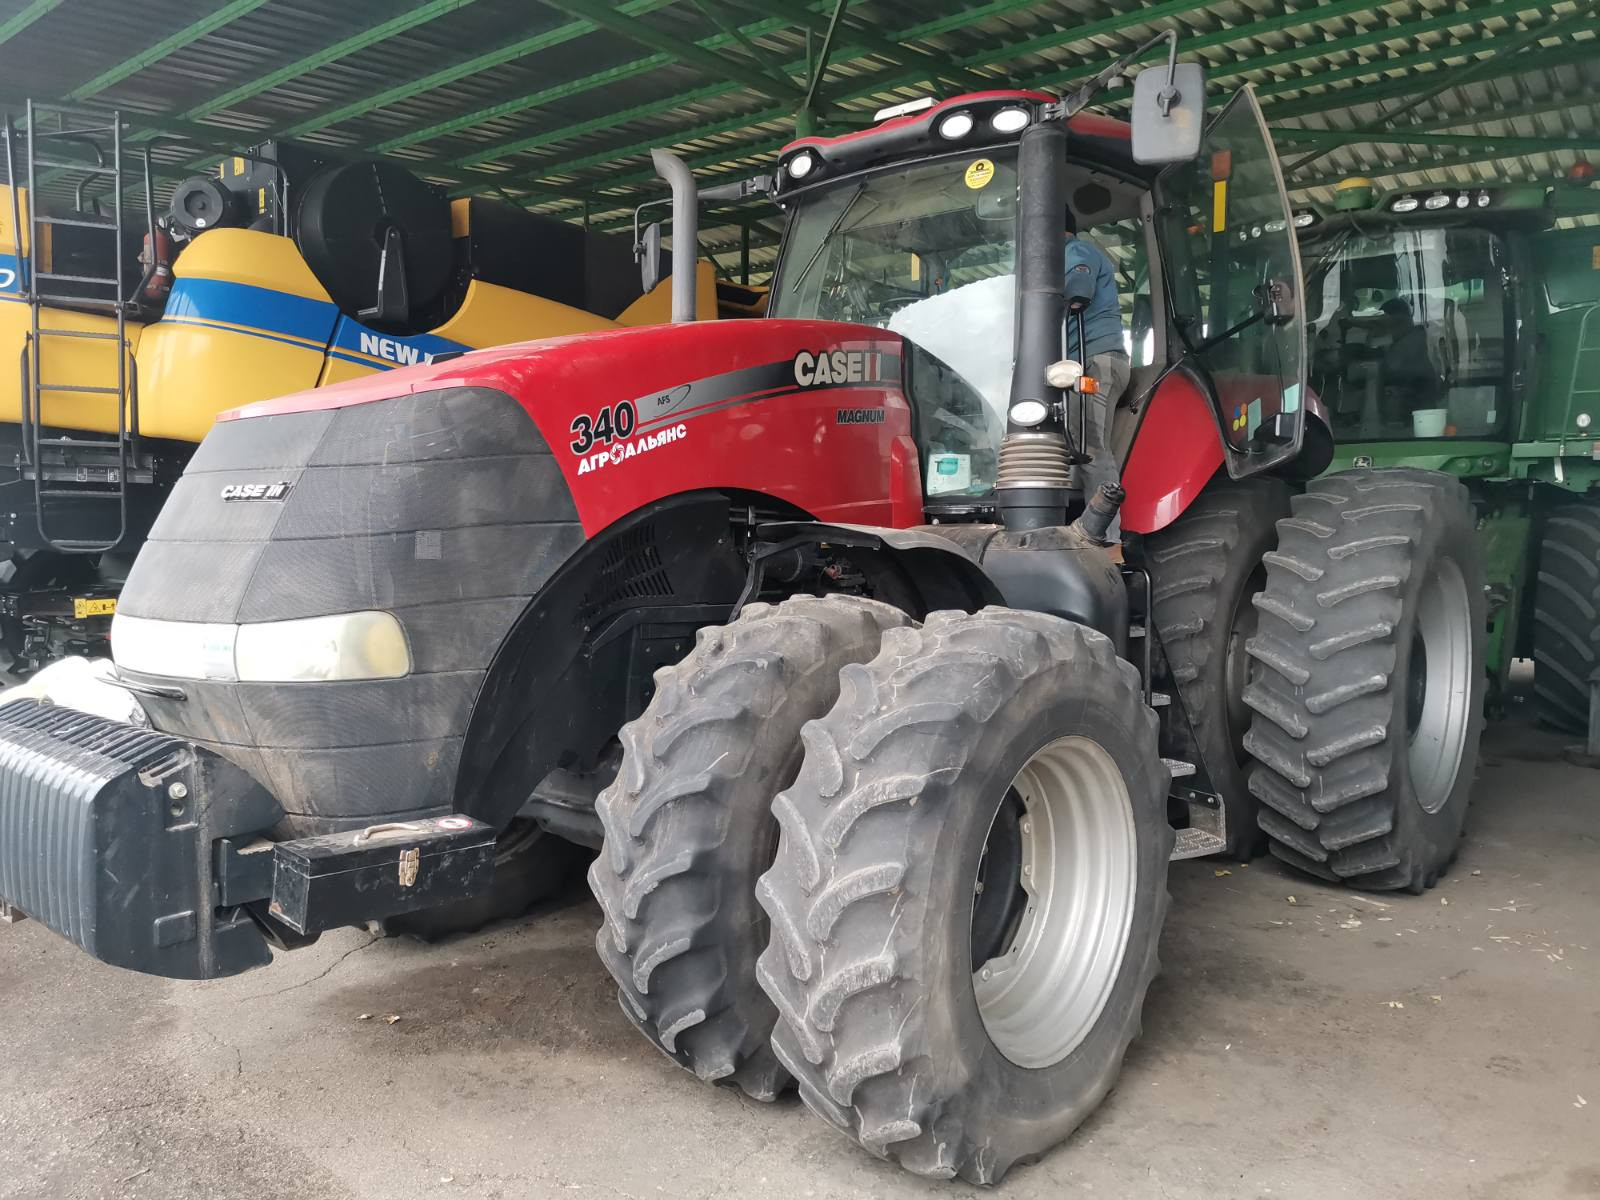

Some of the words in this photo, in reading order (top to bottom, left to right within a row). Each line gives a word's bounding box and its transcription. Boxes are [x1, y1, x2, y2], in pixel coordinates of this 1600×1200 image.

[360, 332, 419, 366] NEW
[794, 351, 862, 387] CASE
[657, 394, 671, 406] AFS
[836, 408, 885, 424] MAGNUM
[570, 400, 635, 456] 340
[577, 423, 688, 476] АГРОАЛЬЯНС
[220, 484, 268, 499] CASE
